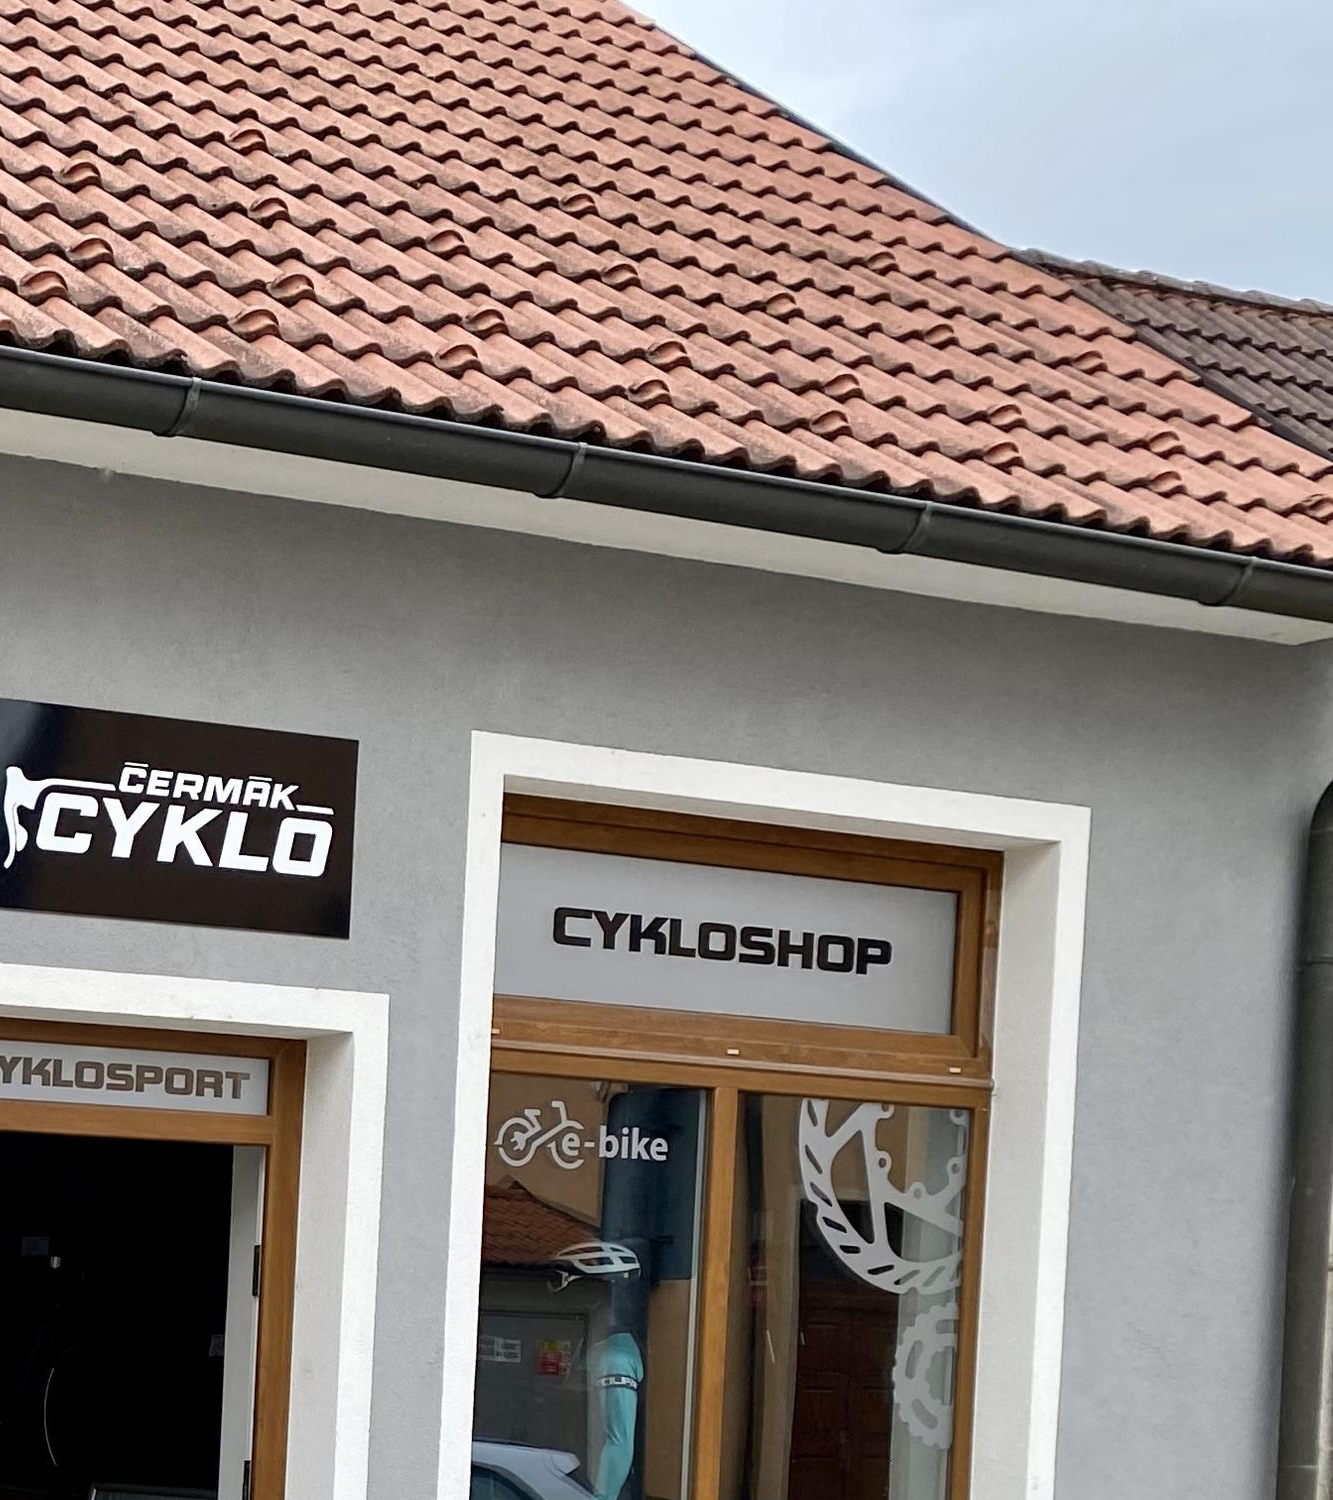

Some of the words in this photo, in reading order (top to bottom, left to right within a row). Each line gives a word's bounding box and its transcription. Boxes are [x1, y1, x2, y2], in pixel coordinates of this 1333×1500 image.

[36, 791, 333, 878] CYKLO
[552, 906, 893, 975] CYKLOSHOP
[561, 1126, 669, 1161] e-bike
